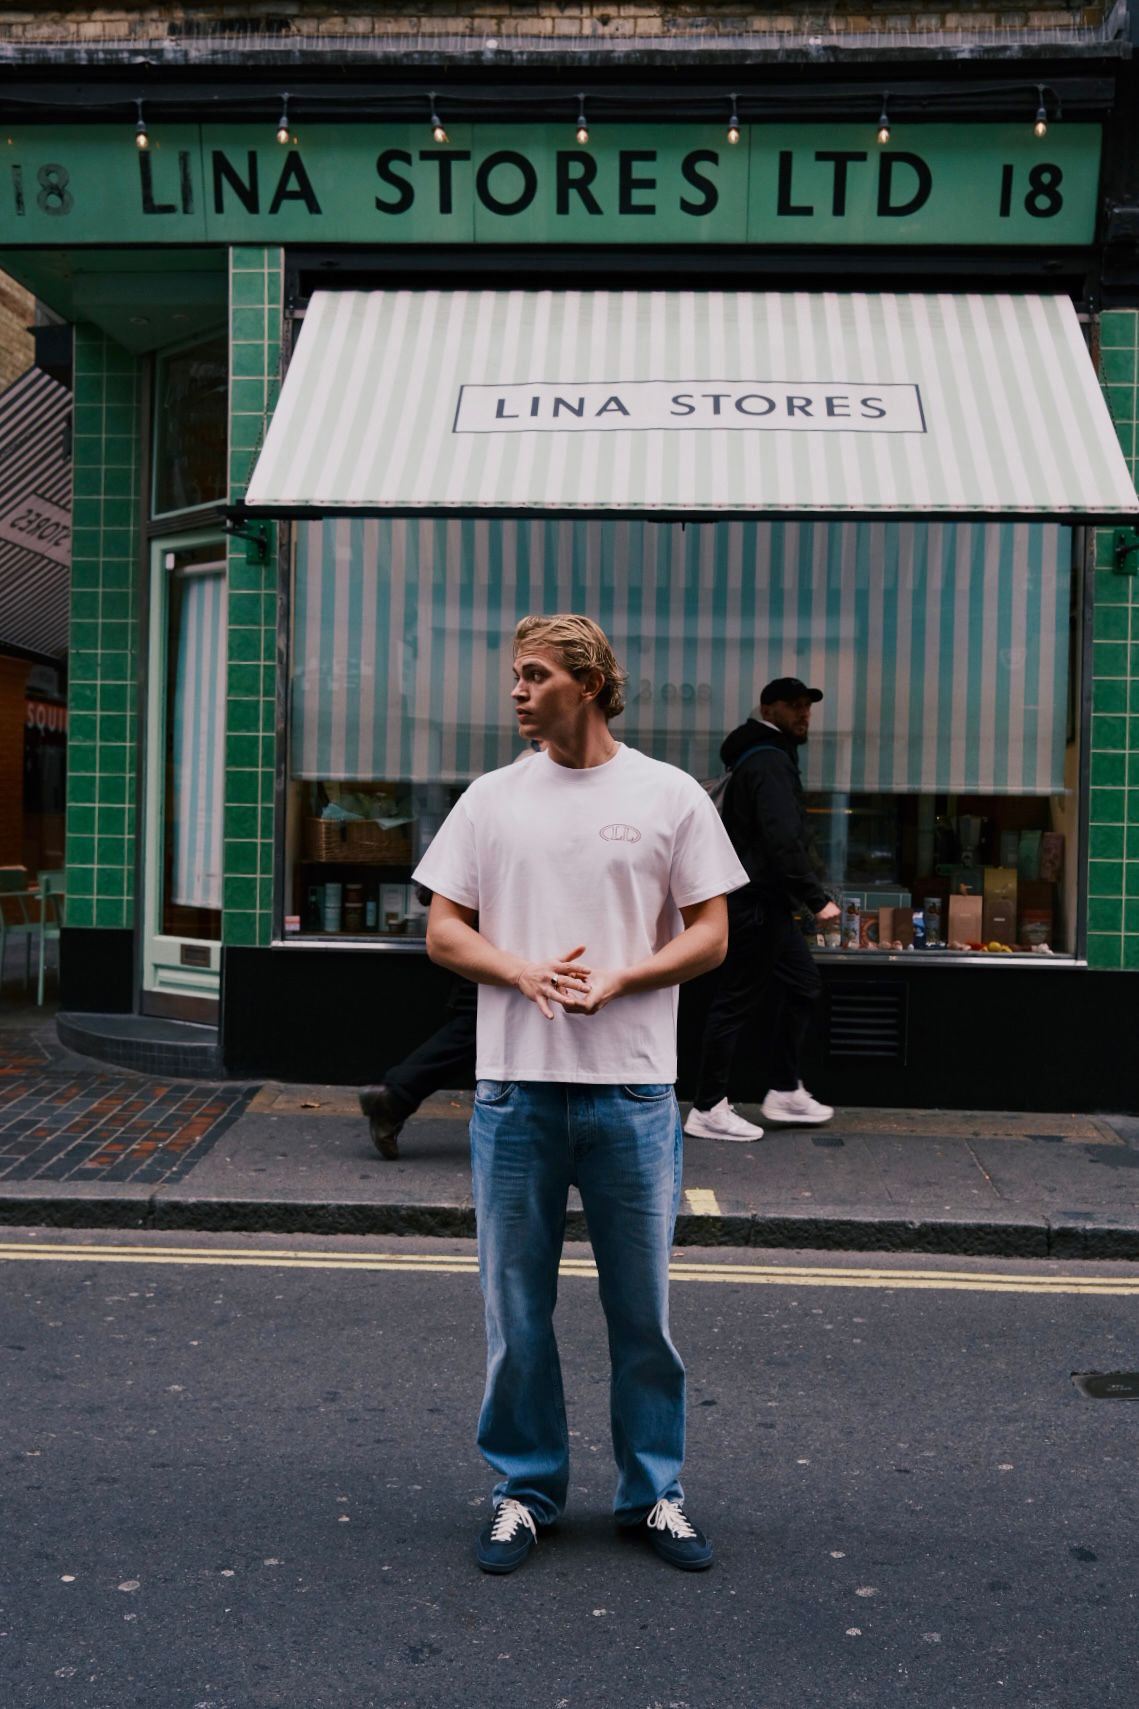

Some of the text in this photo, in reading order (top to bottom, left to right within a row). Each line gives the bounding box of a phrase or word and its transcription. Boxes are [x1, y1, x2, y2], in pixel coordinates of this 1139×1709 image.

[10, 148, 1064, 218] 18 LINA STORES LTD 18
[495, 394, 888, 419] LINA STORES
[26, 701, 67, 736] SQUI
